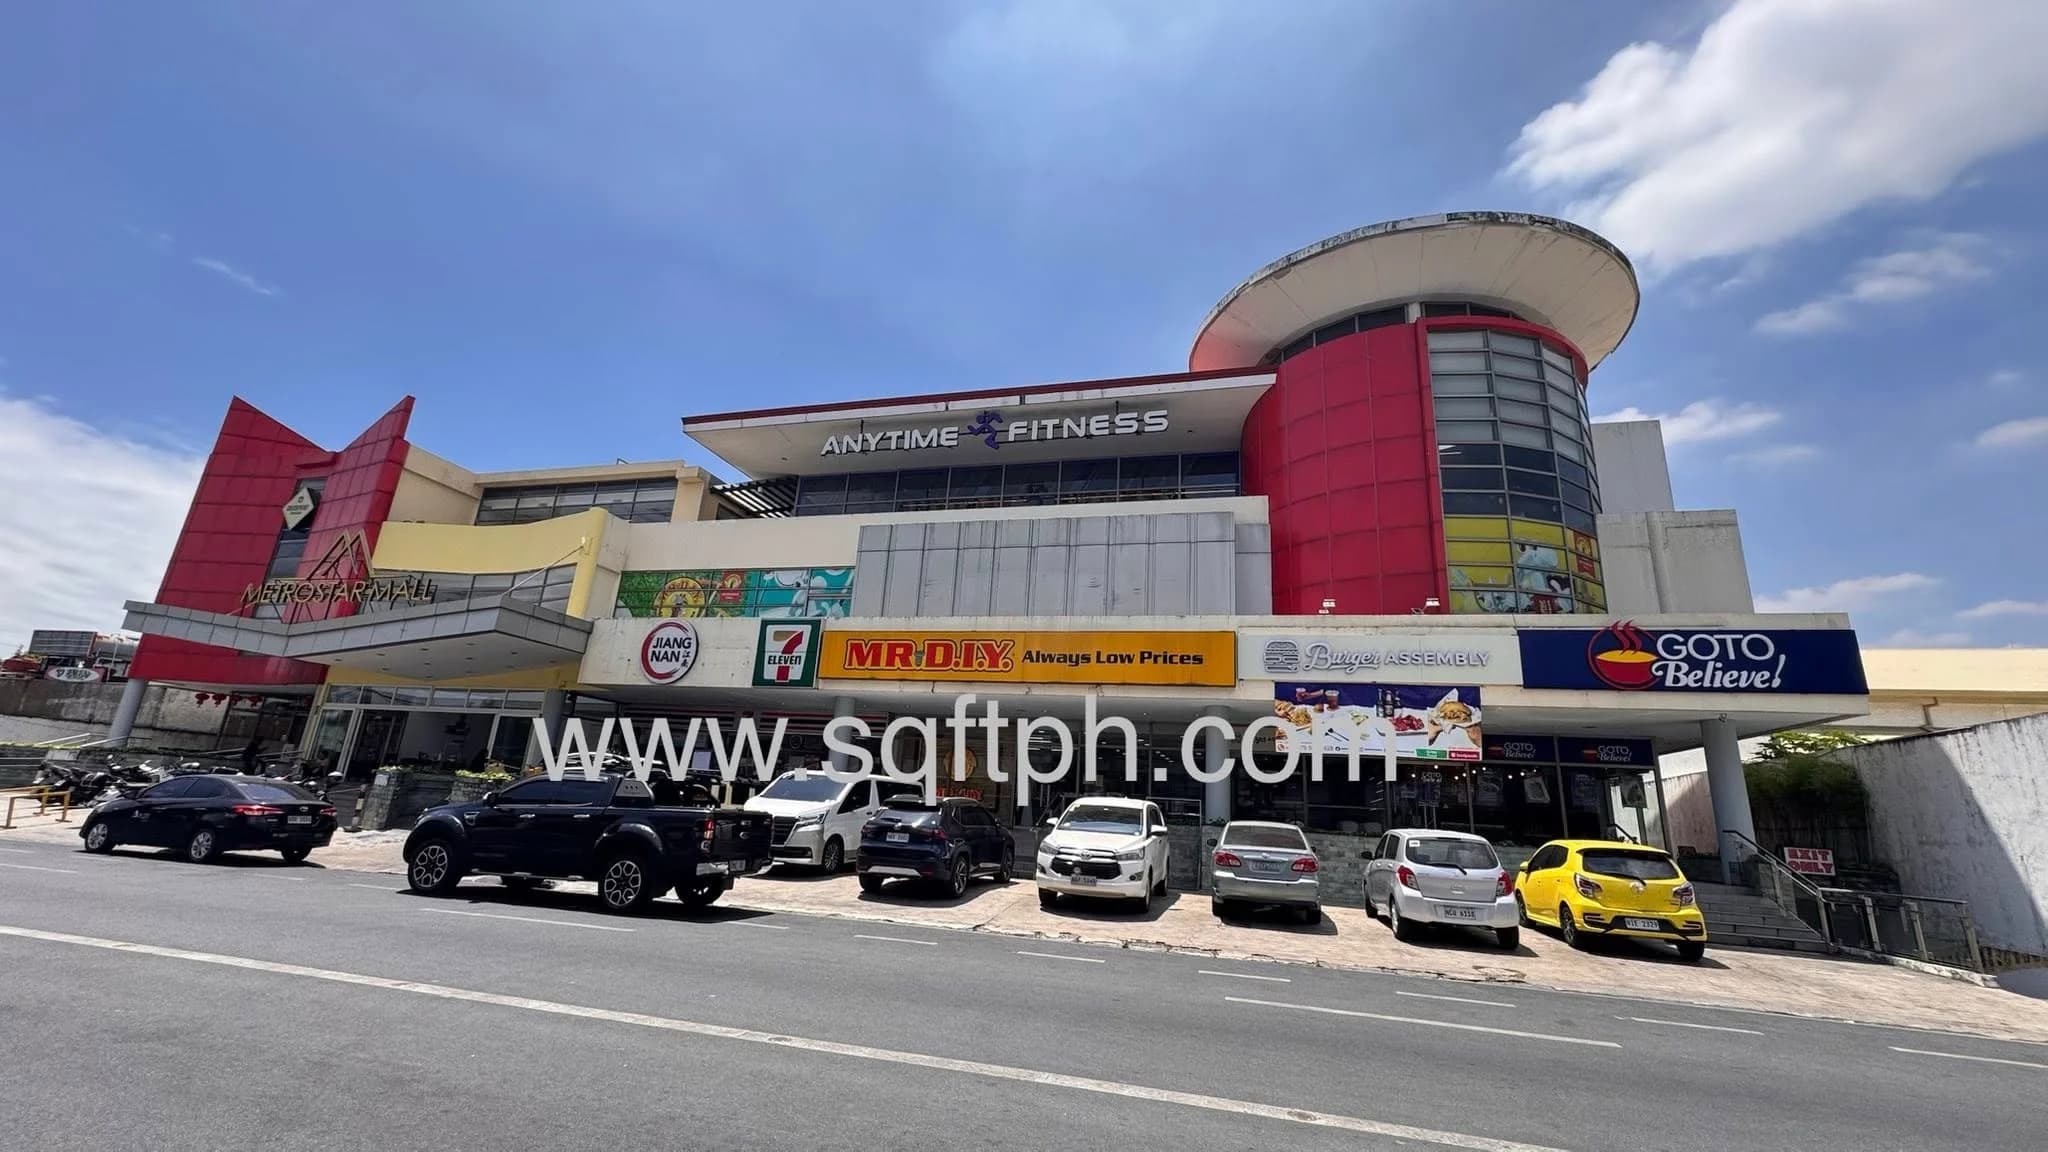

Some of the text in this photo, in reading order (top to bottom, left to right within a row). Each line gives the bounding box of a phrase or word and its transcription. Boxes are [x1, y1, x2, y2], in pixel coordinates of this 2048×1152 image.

[820, 409, 1170, 456] ANYTIME FITNESS
[240, 578, 432, 604] METROSTAR MALL
[652, 637, 692, 649] JIANG
[1656, 633, 1775, 661] GOTO
[650, 650, 681, 663] NAN
[773, 630, 804, 682] 7
[1022, 650, 1204, 667] Always Low Prices
[1303, 642, 1490, 674] Burger ASSEMBLY
[1651, 654, 1786, 689] Believe!
[1504, 742, 1534, 751] GOTO
[1788, 848, 1830, 861] EXIT
[1787, 860, 1833, 874] ONLY
